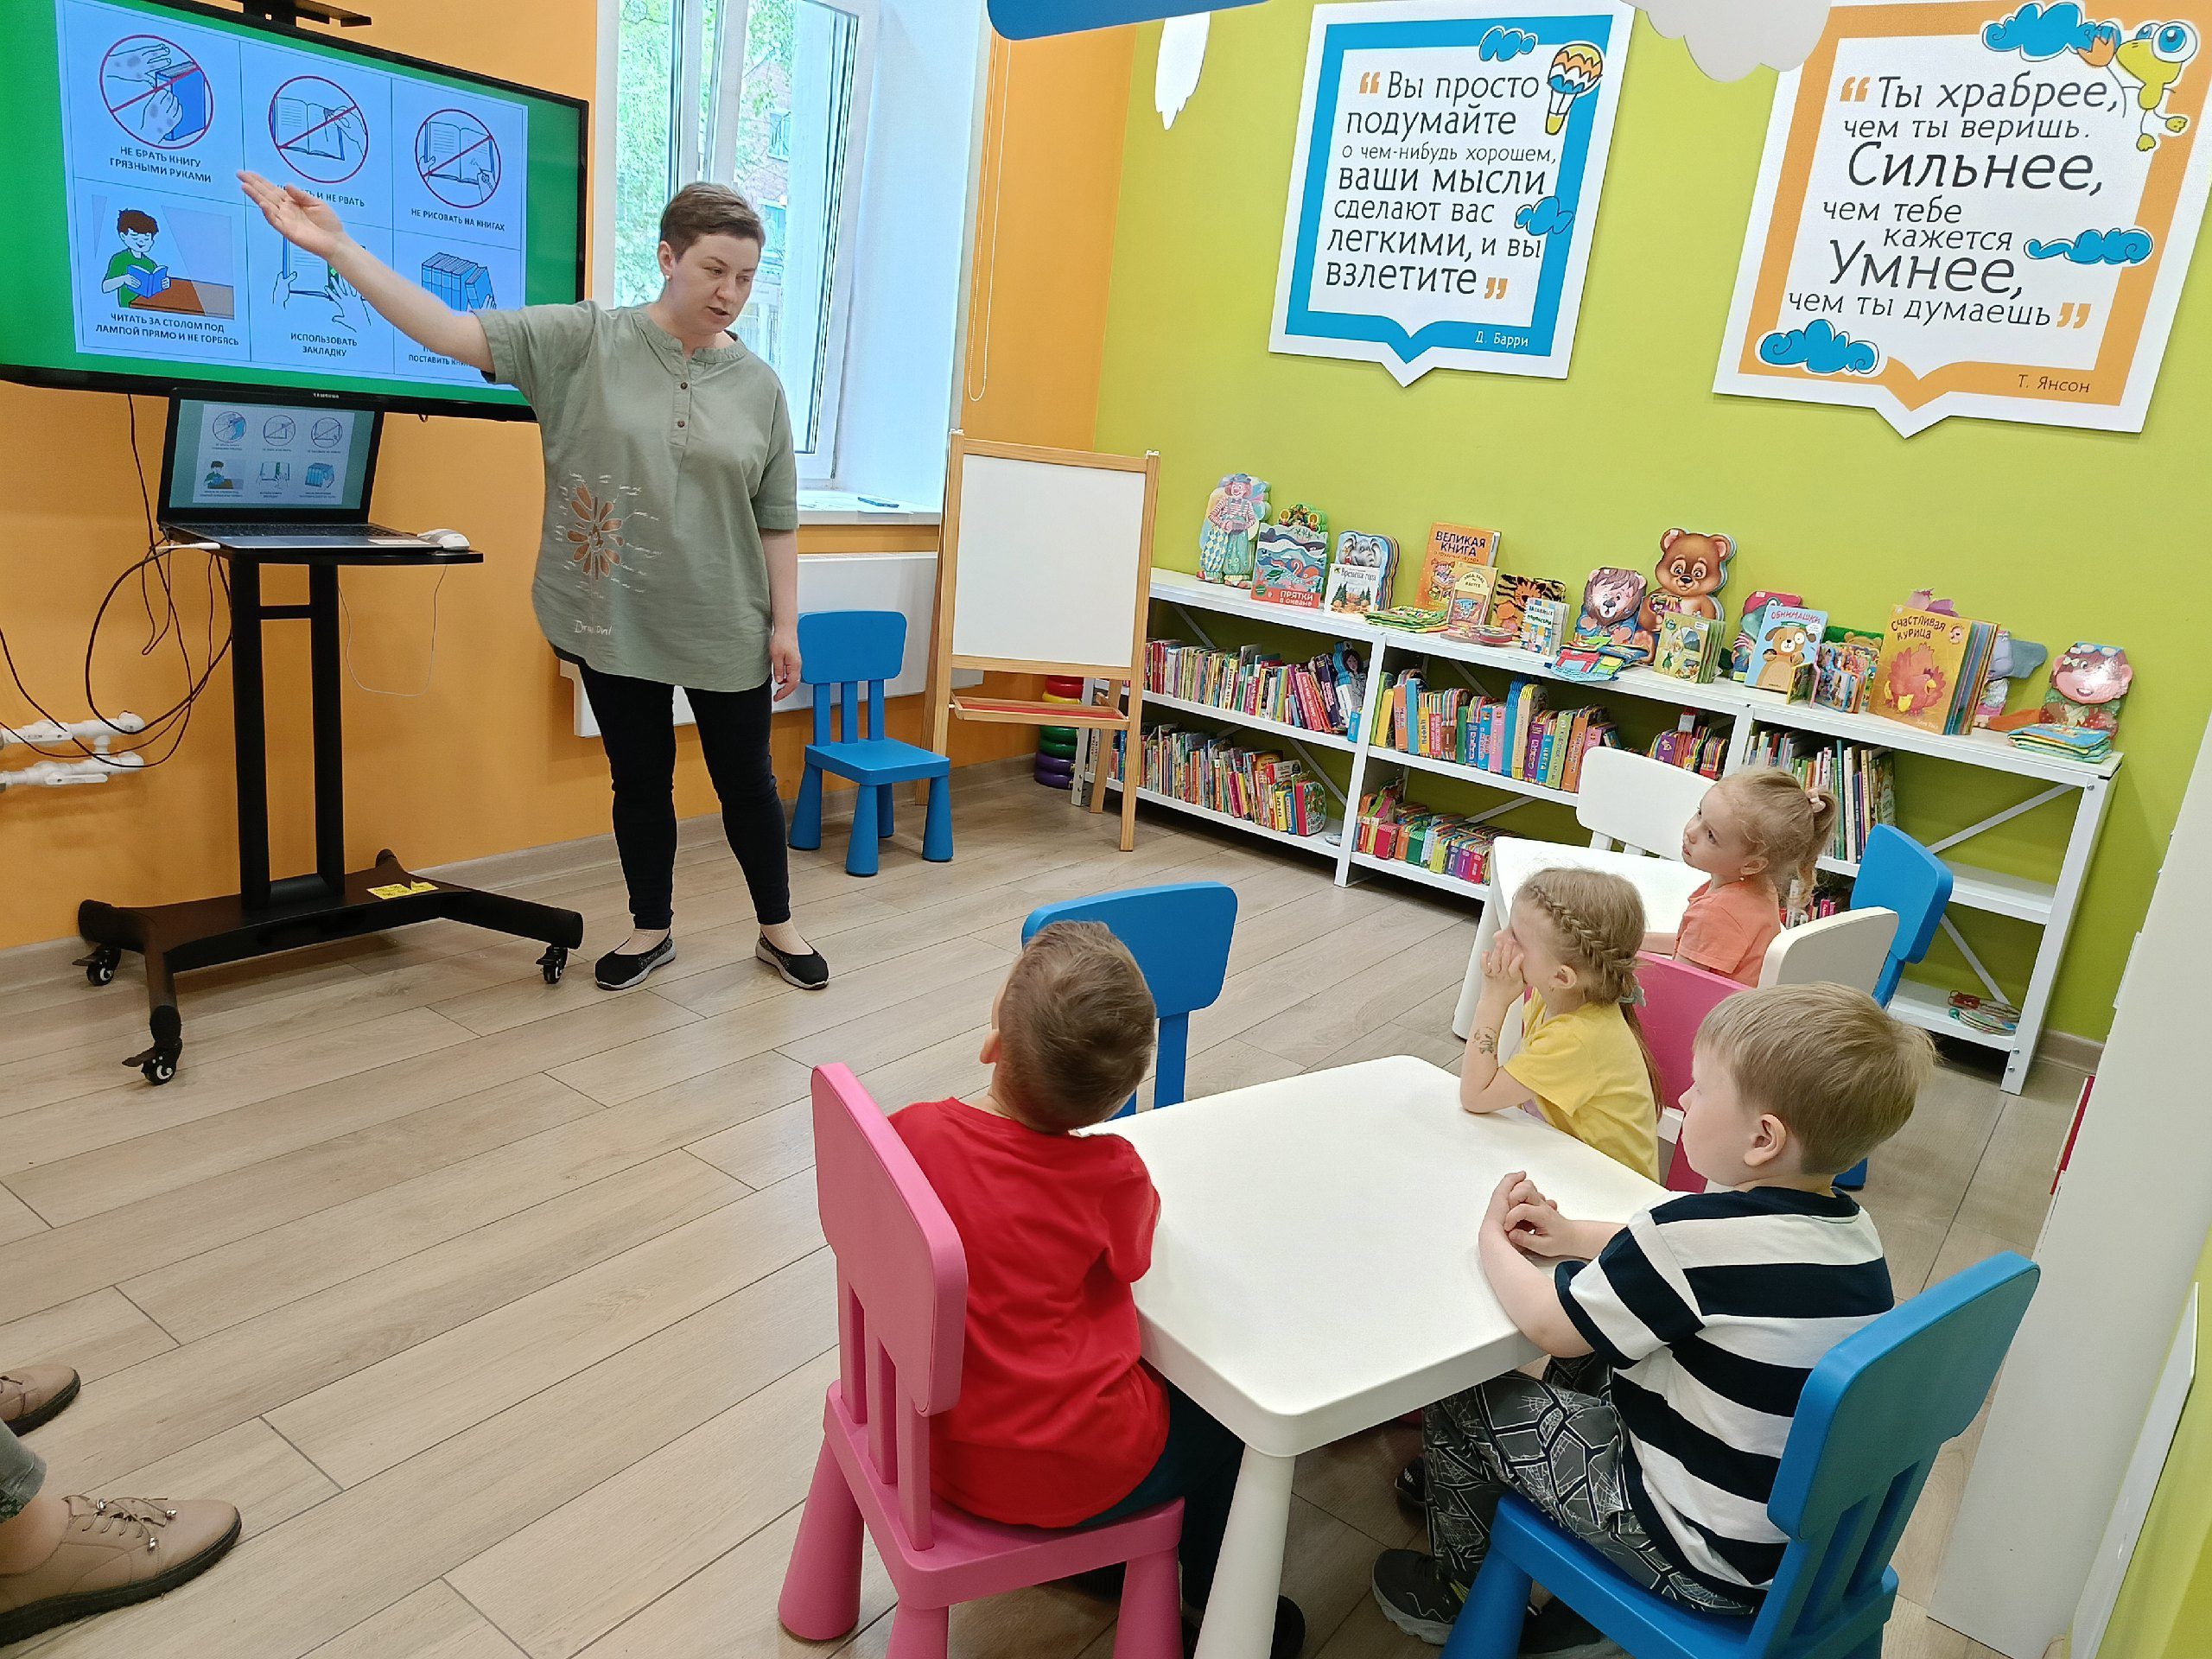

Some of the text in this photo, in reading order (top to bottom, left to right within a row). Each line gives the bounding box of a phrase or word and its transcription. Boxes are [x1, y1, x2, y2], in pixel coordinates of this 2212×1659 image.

[1434, 76, 1539, 107] просто
[1936, 70, 2118, 118] храбрее,
[1346, 103, 1516, 142] подумайте
[1843, 119, 2092, 145] чем ты веришь.
[120, 146, 201, 168] НЕ БРАТЬ КНИГУ
[1342, 142, 1556, 166] о чем-нибудь хорошем,
[110, 157, 212, 183] ГРЯЗНЫМИ РУКАМИ
[1848, 141, 2103, 197] Сильнее,
[1338, 167, 1546, 195] ваши мысли
[326, 194, 336, 203] НЕ
[339, 195, 365, 207] РВАТЬ
[1334, 199, 1495, 223] сделают вас
[1823, 194, 1962, 225] чем тебе
[423, 210, 462, 224] РИСОВАТЬ
[464, 217, 474, 226] НА
[476, 219, 505, 232] КНИГАХ
[1326, 227, 1541, 263] легкими, и вы
[1883, 227, 2013, 251] кажется
[1829, 239, 2023, 301] Умнее,
[1788, 291, 1844, 315] чем
[1858, 296, 1892, 317] ты
[96, 324, 140, 336] ЛАМПОЙ
[142, 328, 176, 340] ПРЯМО
[201, 335, 239, 346] ГОРБЯСЬ
[111, 313, 225, 334] ЧИТАТЬ ЗА СТОЛОМ ПОД
[290, 332, 358, 346] ИСПОЛЬЗОВАТЬ
[1475, 331, 1529, 347] Д. Барри
[302, 346, 347, 357] ЗАКЛАДКУ
[409, 354, 450, 365] ПОСТАВИТЬ
[2018, 373, 2090, 394] Т. Янсон
[1435, 531, 1486, 548] ВЕЛИКАЯ
[1440, 543, 1477, 557] КНИГА
[1280, 590, 1313, 601] ПРЯТКИ
[1771, 611, 1820, 623] ОБНИМАШКИ
